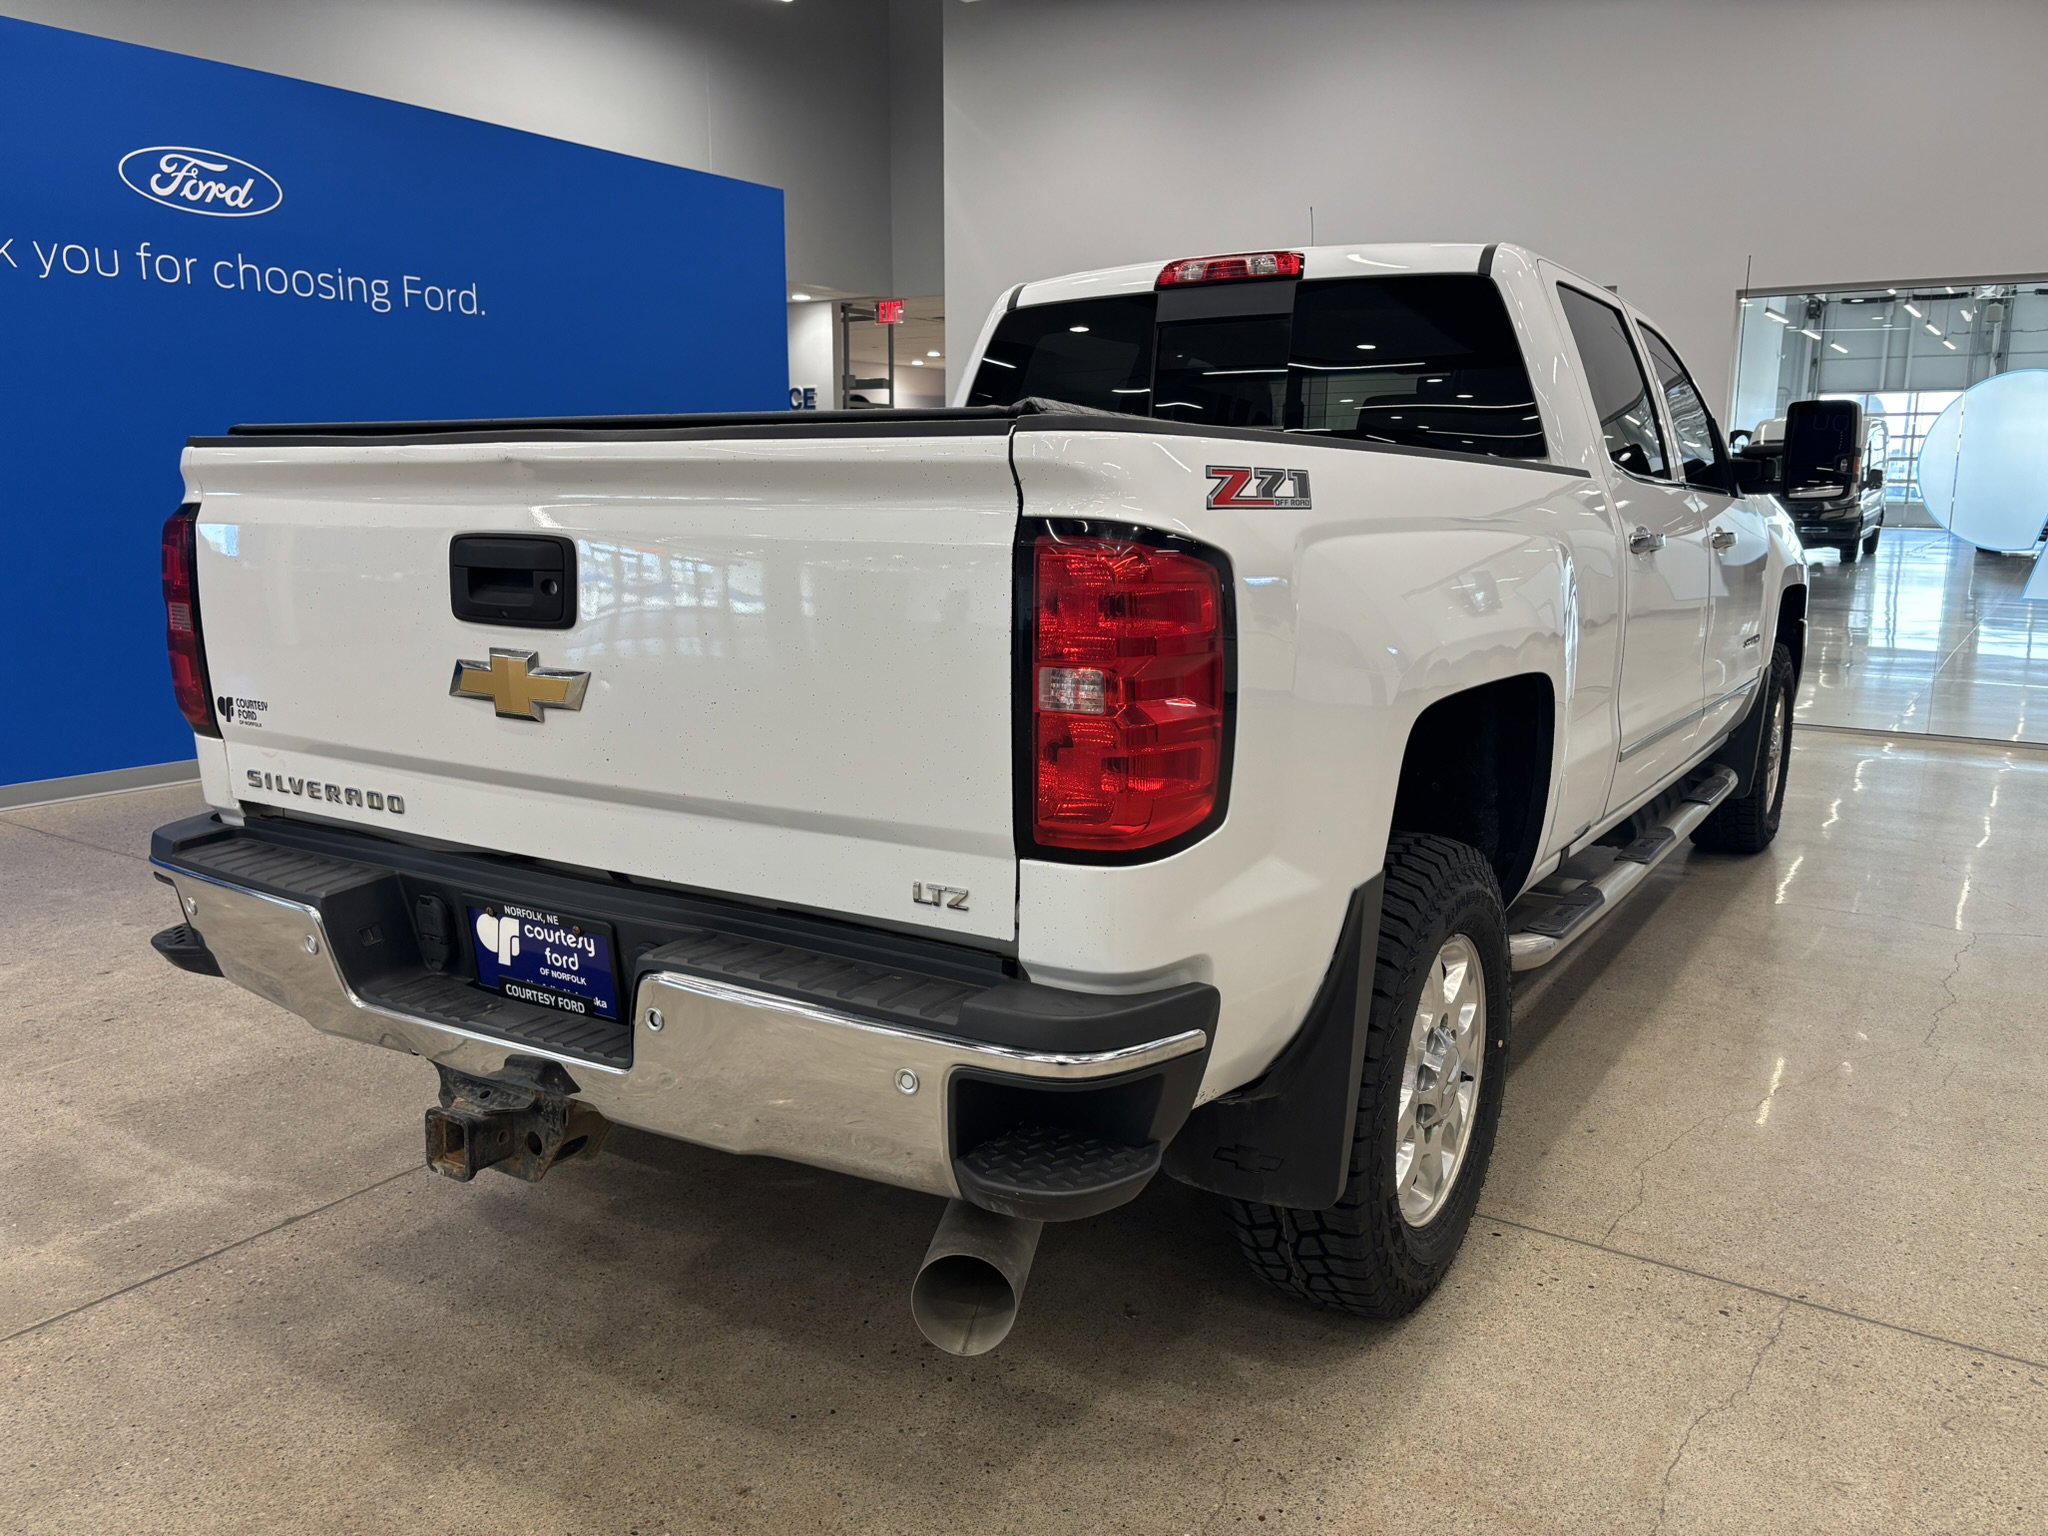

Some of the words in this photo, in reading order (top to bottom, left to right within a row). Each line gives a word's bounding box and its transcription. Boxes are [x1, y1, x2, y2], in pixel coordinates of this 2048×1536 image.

[149, 153, 255, 209] Ford
[32, 240, 120, 279] you
[136, 242, 197, 285] for
[212, 253, 392, 313] choosing
[402, 275, 486, 316] Ford.
[879, 302, 901, 322] EXIT
[1205, 464, 1312, 511] Z71
[1290, 499, 1310, 507] ROAD
[236, 697, 268, 711] COURTESY
[238, 709, 257, 721] FORD
[247, 769, 405, 815] SILVERADO
[912, 881, 969, 911] LTZ
[504, 905, 546, 924] NORFOLK,
[547, 914, 560, 925] NE
[524, 924, 596, 958] courtesy
[544, 946, 580, 971] ford
[540, 967, 550, 976] OF
[551, 970, 587, 985] NORFOLK
[505, 984, 556, 1007] COURTESY
[557, 996, 586, 1014] FORD
